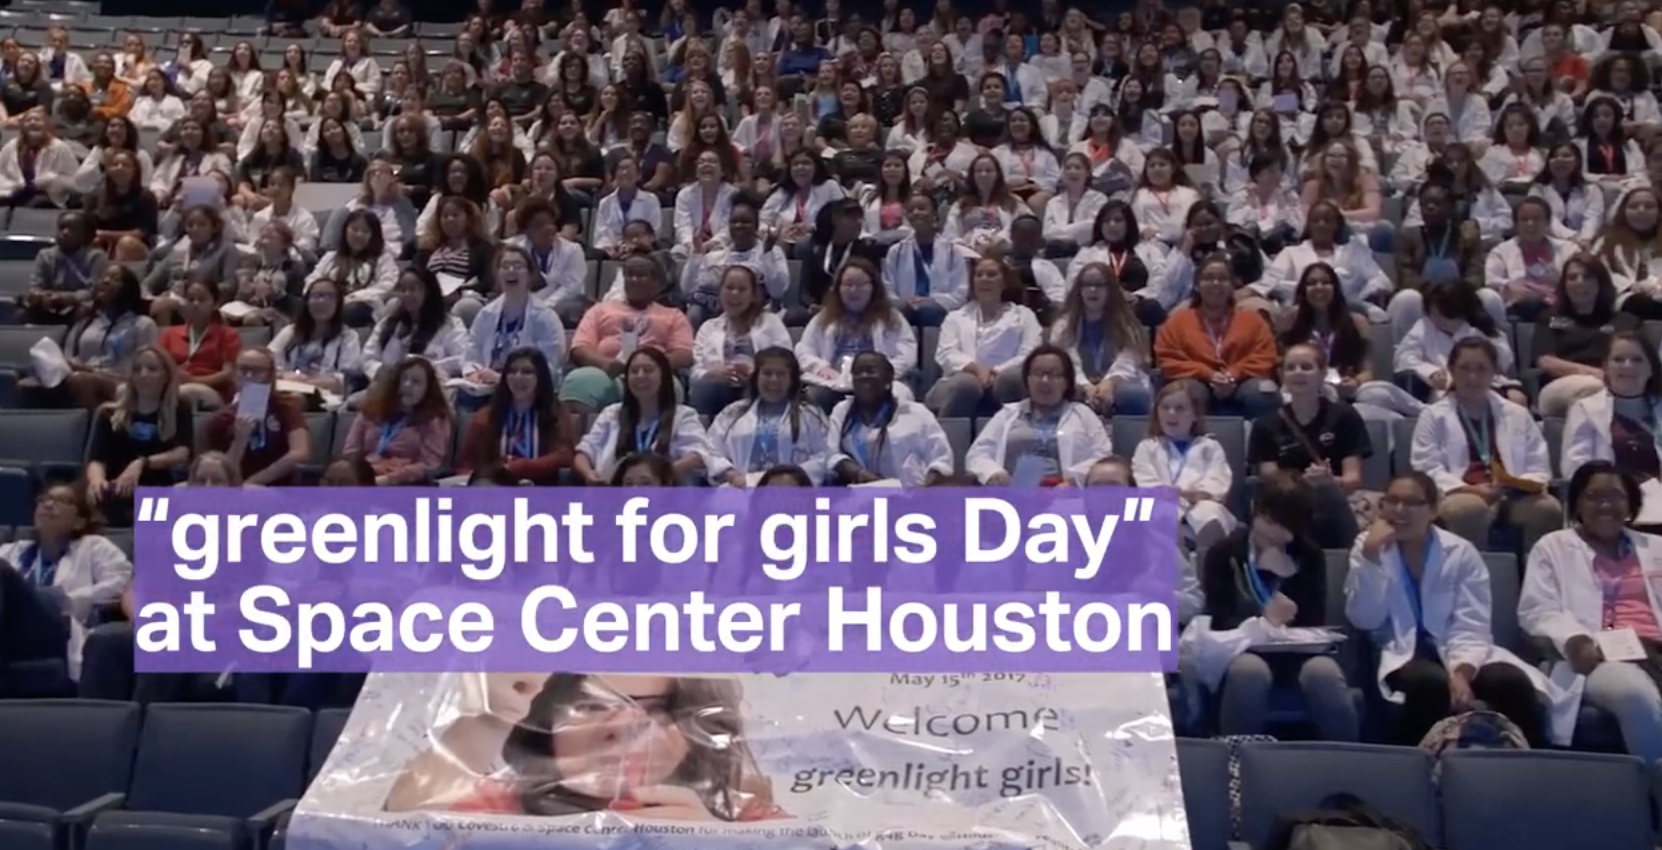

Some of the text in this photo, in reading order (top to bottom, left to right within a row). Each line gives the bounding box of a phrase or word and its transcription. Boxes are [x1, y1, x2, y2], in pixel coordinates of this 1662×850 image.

[889, 672, 935, 688] May
[982, 672, 1026, 683] 2017
[833, 704, 1060, 738] Welcome
[790, 757, 1093, 799] greenlight girls!
[634, 821, 696, 836] Houston
